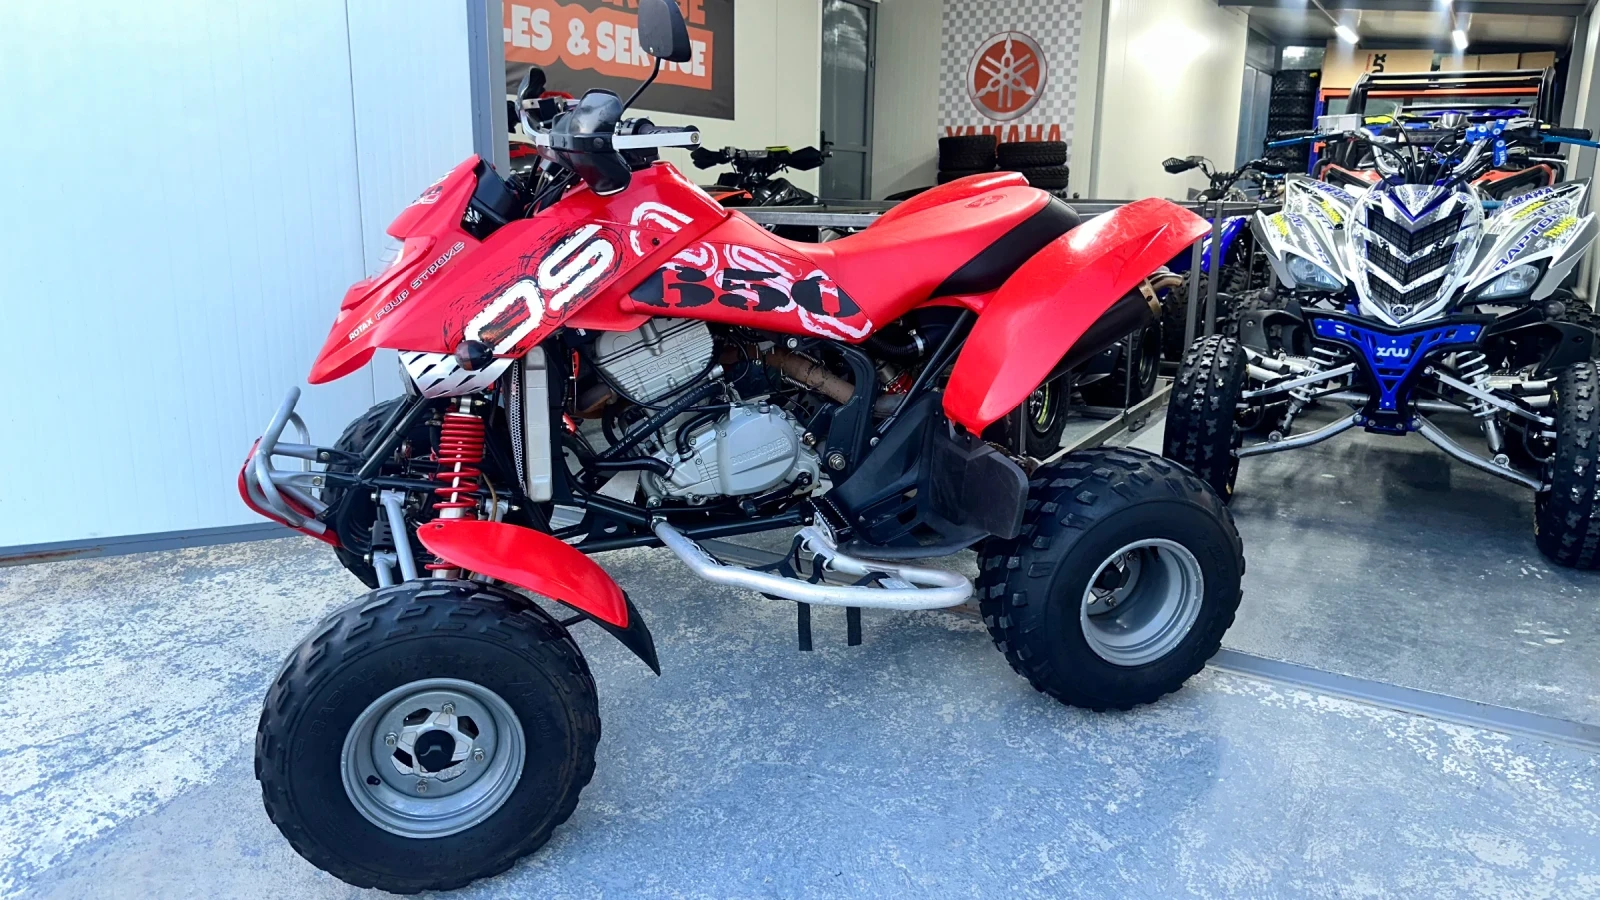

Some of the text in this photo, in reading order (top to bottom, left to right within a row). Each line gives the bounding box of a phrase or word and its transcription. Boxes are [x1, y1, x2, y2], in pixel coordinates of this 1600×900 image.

[502, 4, 552, 51] ES
[566, 18, 590, 56] &
[596, 20, 706, 77] SERE
[348, 317, 374, 341] ROTAX
[410, 241, 465, 290] STROKE
[730, 436, 789, 466] BOMBARDIER
